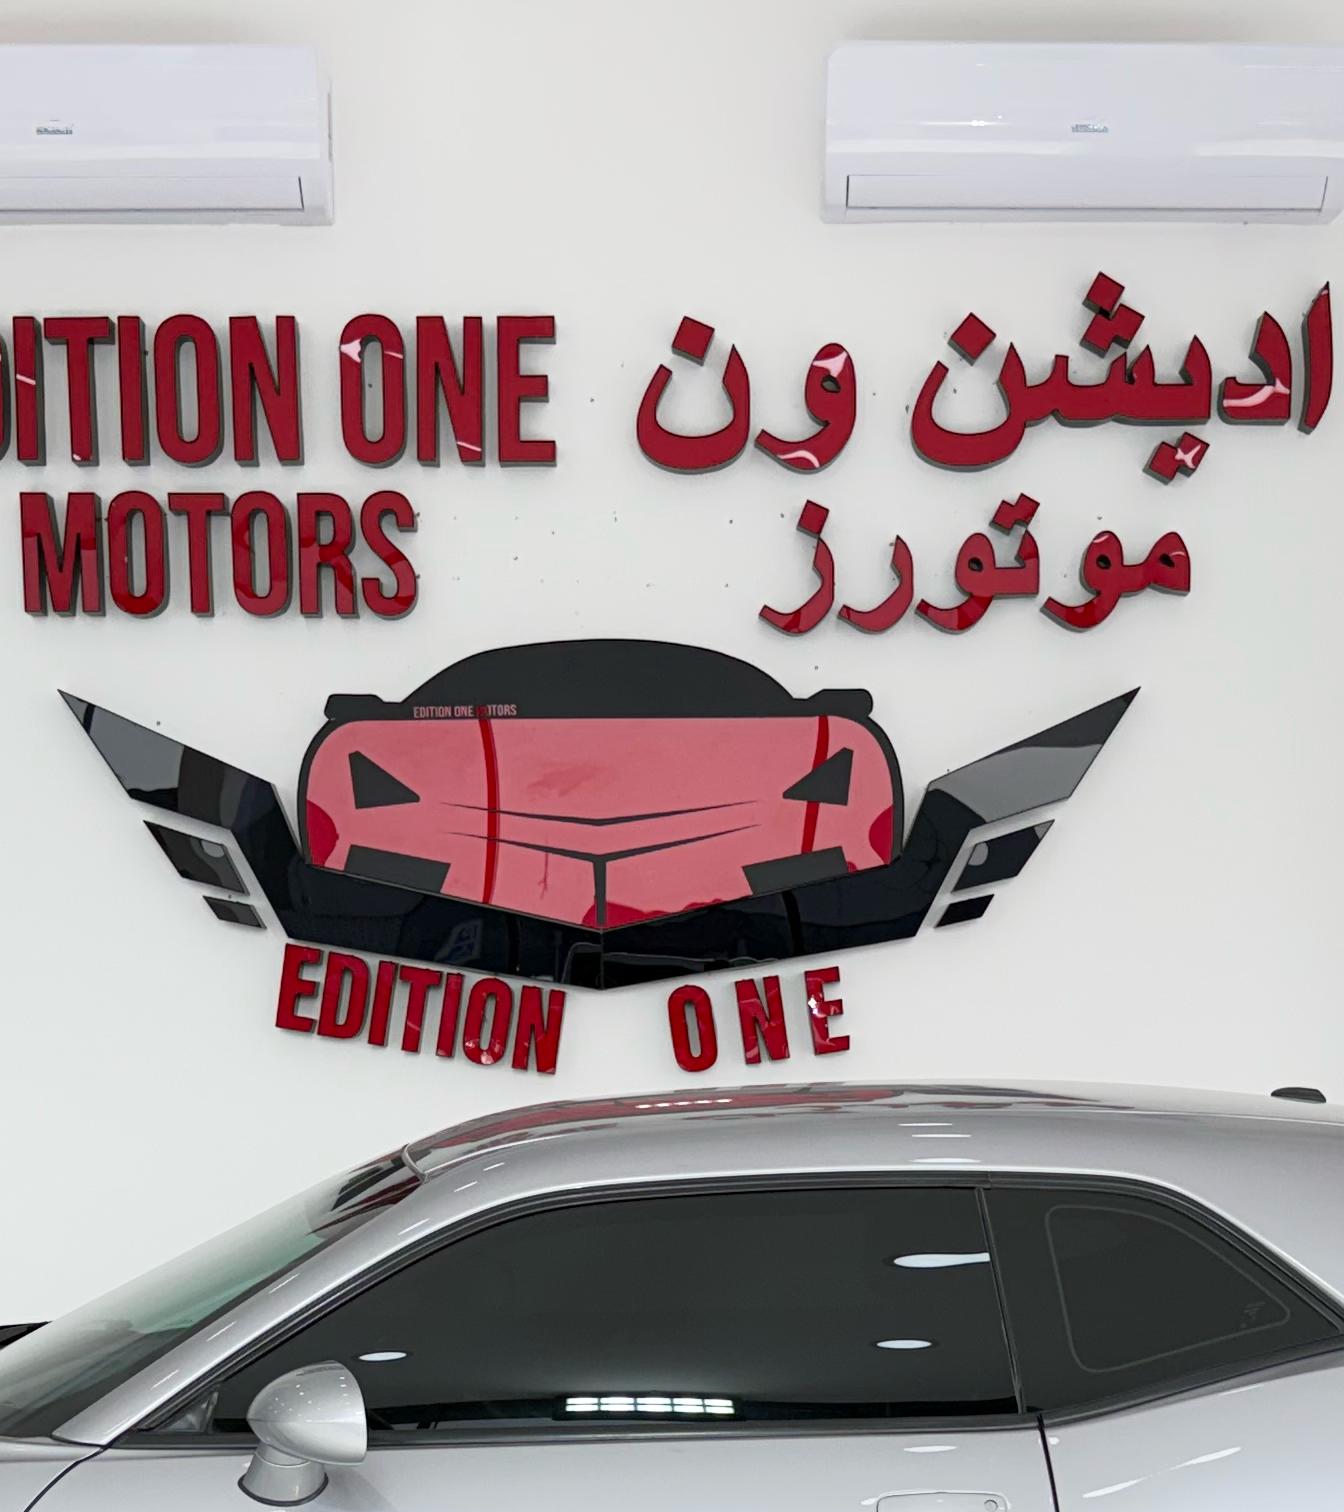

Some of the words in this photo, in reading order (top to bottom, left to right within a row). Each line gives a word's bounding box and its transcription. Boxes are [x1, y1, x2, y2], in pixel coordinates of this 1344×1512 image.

[339, 313, 558, 464] ONE
[636, 317, 858, 472] ون
[911, 273, 1334, 482] اديشن
[19, 490, 419, 617] MOTORS
[759, 494, 1193, 635] موتورز
[413, 706, 451, 718] EDITION
[454, 706, 473, 717] ONE
[275, 943, 566, 1075] EDITION
[666, 965, 851, 1073] ONE
